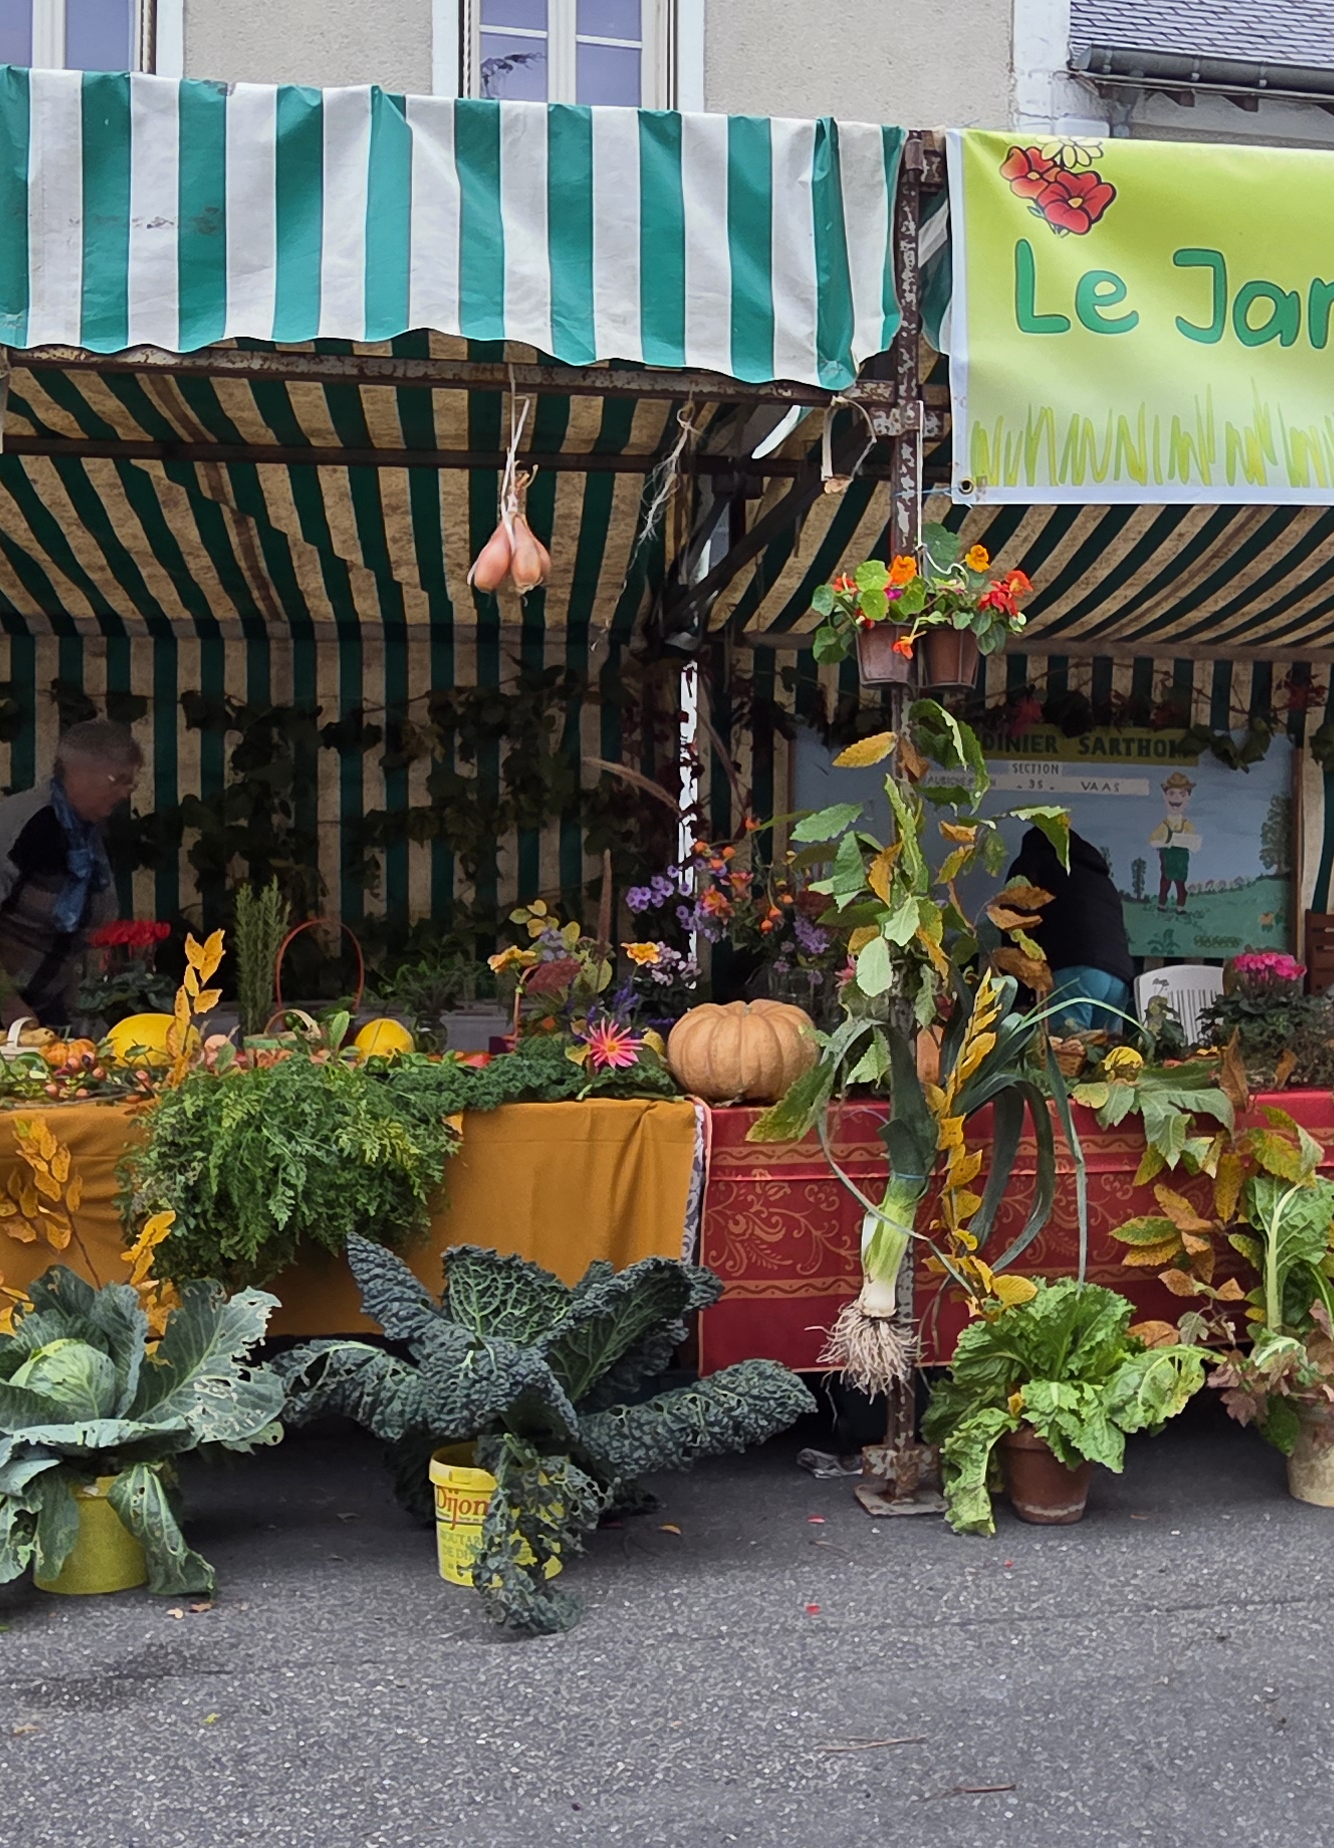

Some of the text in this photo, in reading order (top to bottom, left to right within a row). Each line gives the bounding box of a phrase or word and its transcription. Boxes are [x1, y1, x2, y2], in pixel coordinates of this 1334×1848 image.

[1015, 239, 1140, 335] Le
[982, 732, 1176, 759] DINIER SARTHOI
[1012, 762, 1059, 775] SECTION
[1080, 781, 1120, 793] VAAS
[436, 1486, 490, 1530] Dijon
